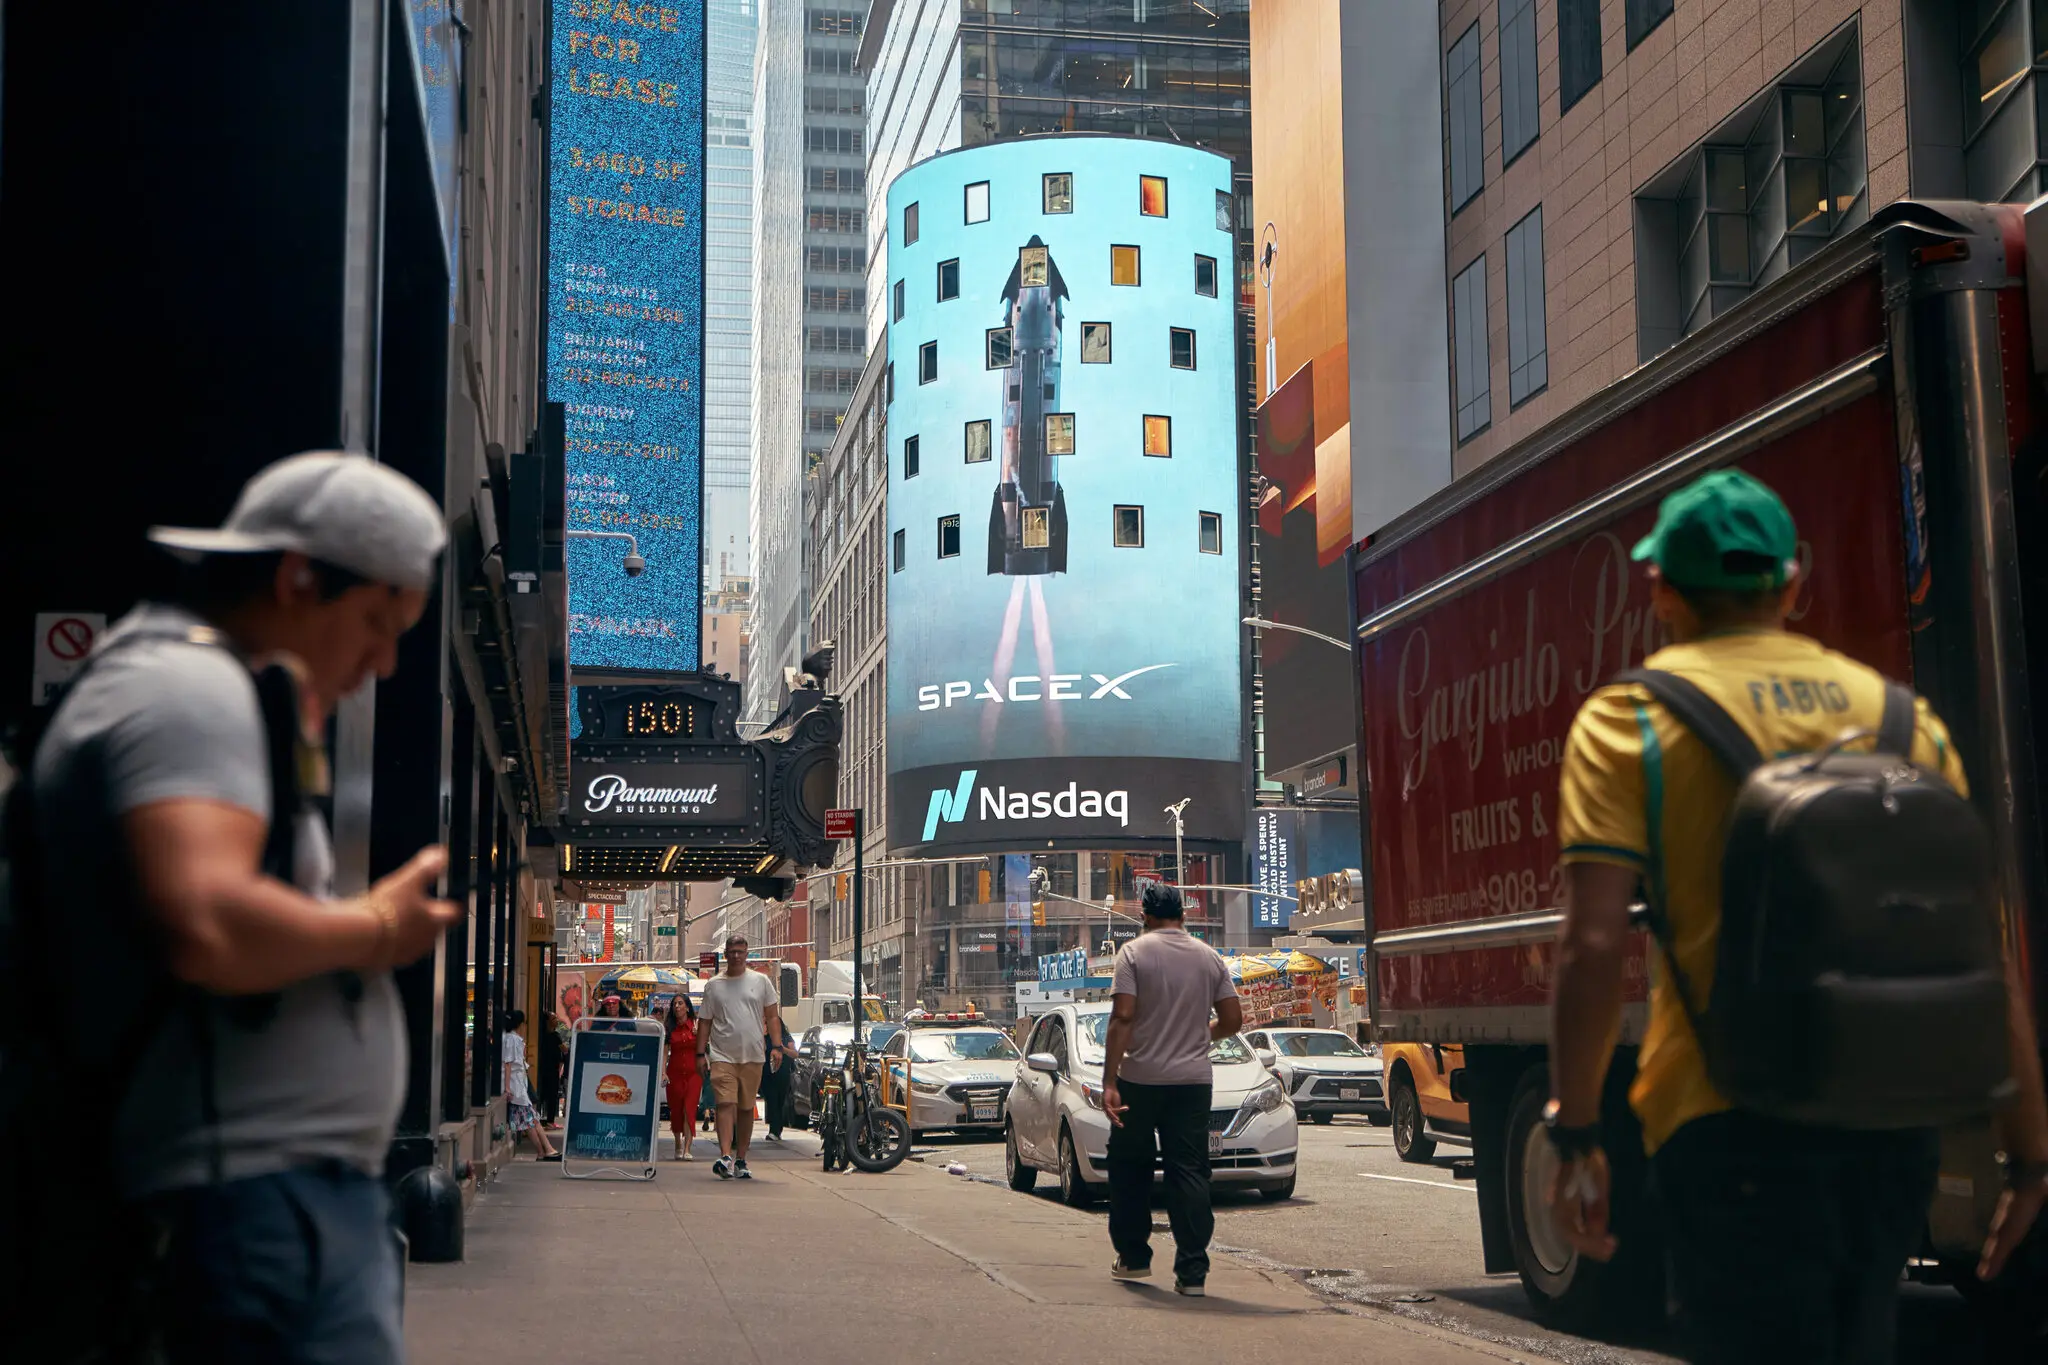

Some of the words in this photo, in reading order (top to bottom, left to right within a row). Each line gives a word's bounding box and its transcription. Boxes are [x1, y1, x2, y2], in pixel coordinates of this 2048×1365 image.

[569, 0, 680, 34] SPACE
[569, 29, 640, 64] FOR
[569, 67, 679, 107] LEASE
[569, 146, 646, 176] 3,460
[653, 158, 688, 181] SF
[567, 195, 686, 228] STORAGE
[918, 663, 1180, 711] SPACEX
[627, 701, 694, 733] 1501
[1397, 626, 1560, 795] Gargiulo
[584, 774, 718, 812] Paramount
[1304, 770, 1326, 792] branded
[616, 805, 701, 814] BUILDING
[980, 781, 1128, 827] Nasdaq
[1259, 816, 1267, 850] SPEND
[1451, 797, 1521, 853] FRUITS
[1532, 791, 1548, 837] &
[1269, 812, 1277, 867] INSTANTLY
[1279, 837, 1287, 868] GLINT
[588, 892, 622, 900] SPECTACOLOR
[1271, 898, 1279, 925] REAL
[1114, 930, 1136, 938] Nasdaq
[600, 1052, 634, 1060] DELI
